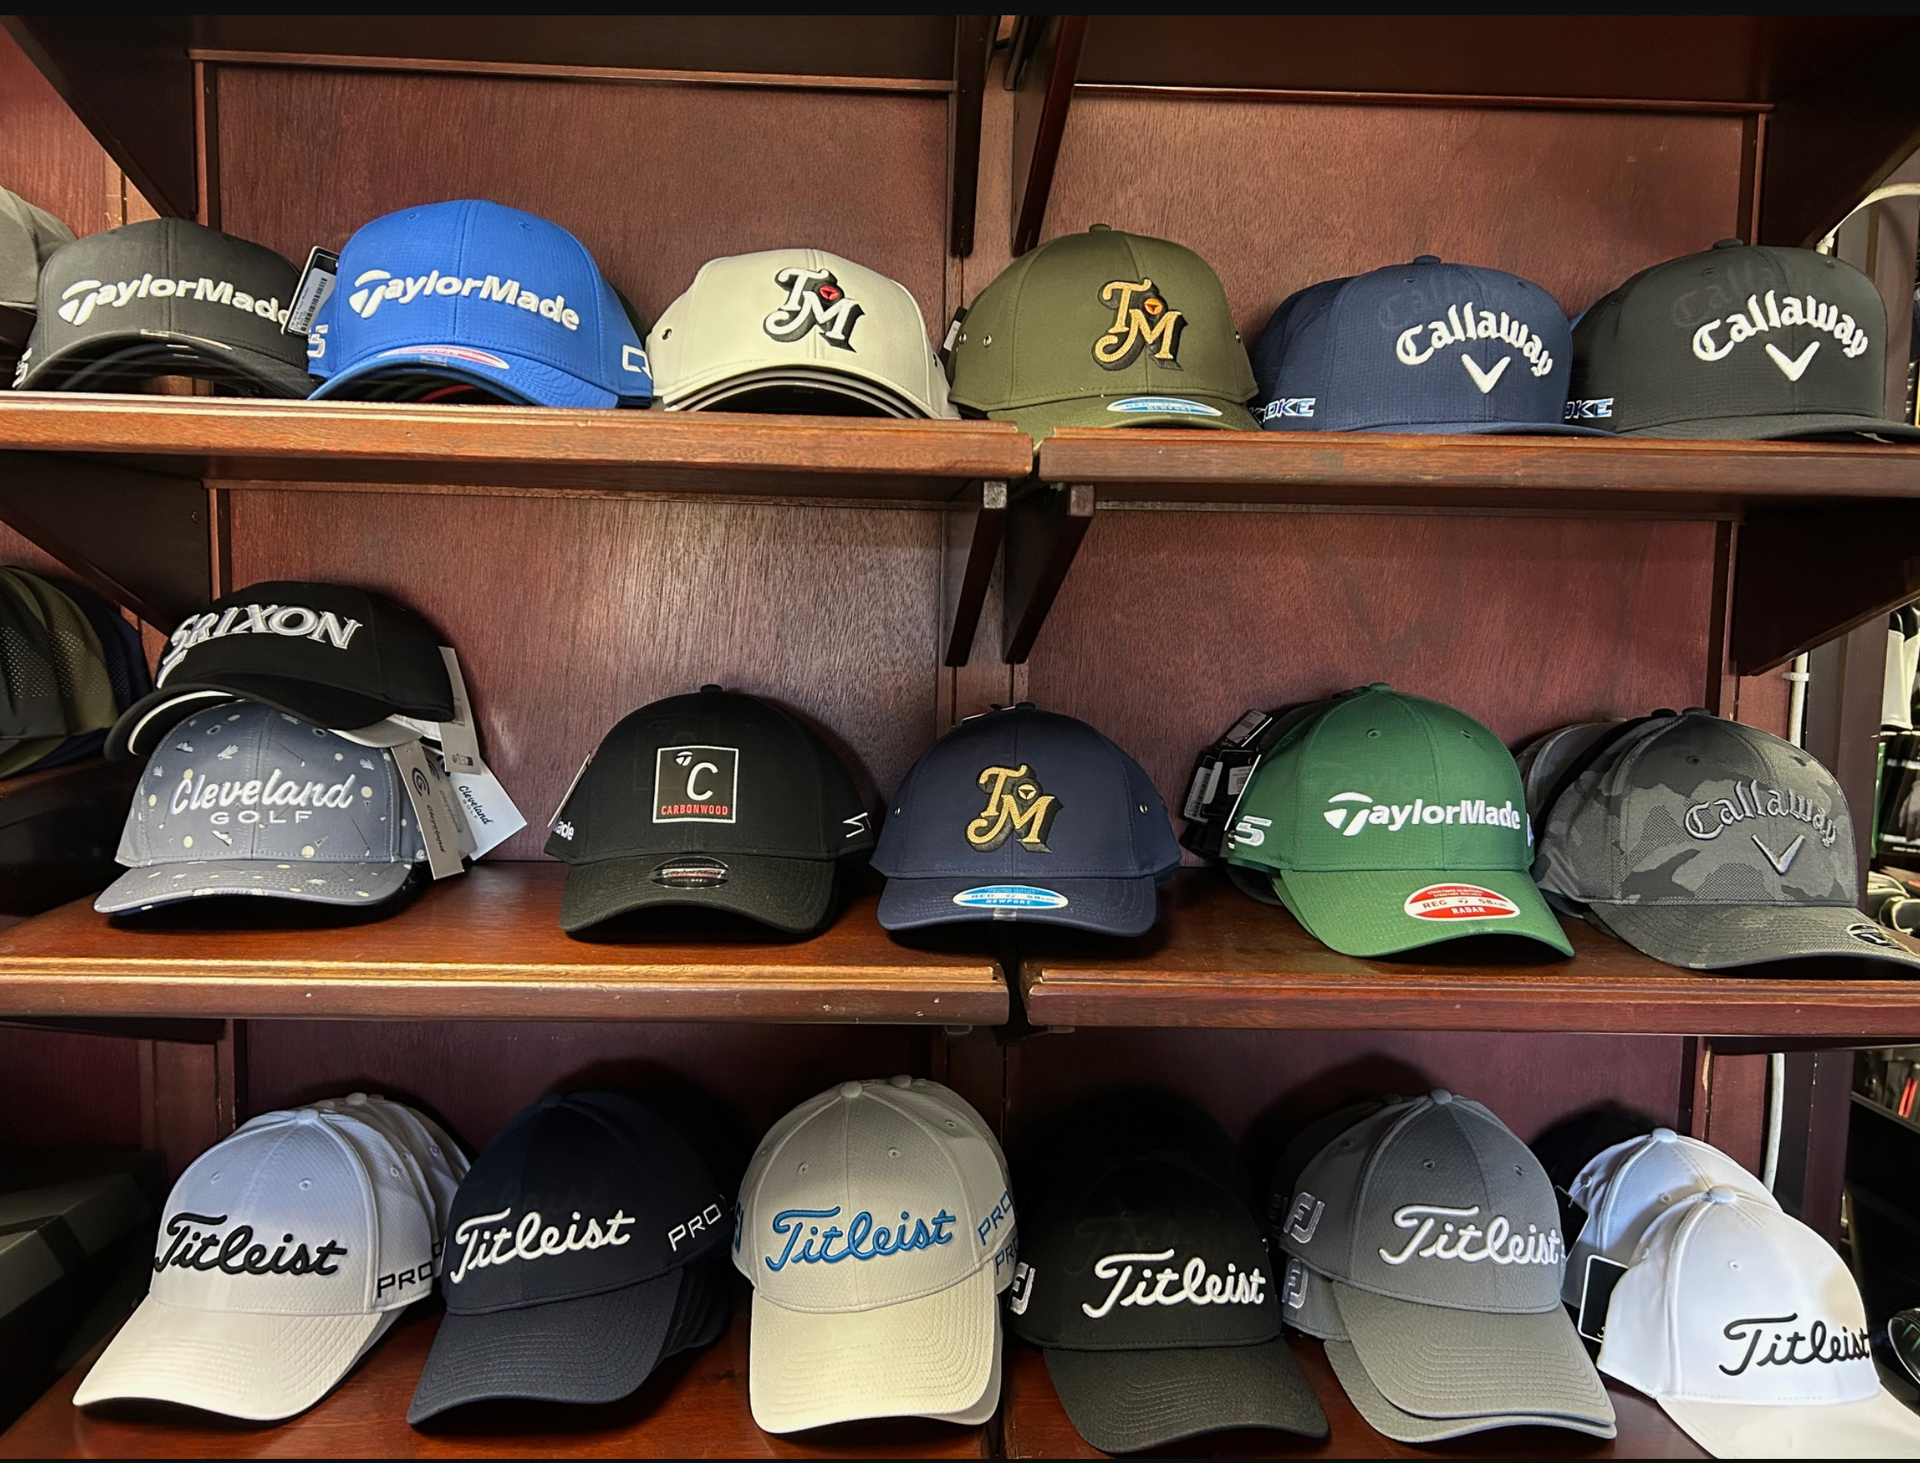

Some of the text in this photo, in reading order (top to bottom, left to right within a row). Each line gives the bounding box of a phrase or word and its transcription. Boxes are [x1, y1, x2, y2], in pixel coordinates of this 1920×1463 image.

[349, 269, 580, 331] TaylorMade
[1692, 289, 1869, 359] Callaway
[1396, 302, 1553, 378] Callaway
[156, 604, 363, 689] SRIXON
[170, 768, 357, 815] Cleveland
[459, 785, 494, 825] Cleveland
[661, 804, 729, 816] CARBONWOOD
[686, 762, 719, 801] C
[209, 809, 313, 825] GOLF
[1323, 792, 1521, 837] TaylorMade
[1684, 779, 1838, 848] Callaway
[1422, 899, 1448, 909] REG
[1450, 906, 1486, 915] RADAR
[153, 1212, 348, 1276] Titleist
[449, 1207, 636, 1285] Titleist
[667, 1203, 722, 1252] PRO
[765, 1206, 956, 1272] Titleist
[1378, 1205, 1561, 1266] Titleist
[377, 1260, 433, 1299] PRO
[1081, 1248, 1267, 1319] Titleist
[1718, 1312, 1870, 1376] Titleist
